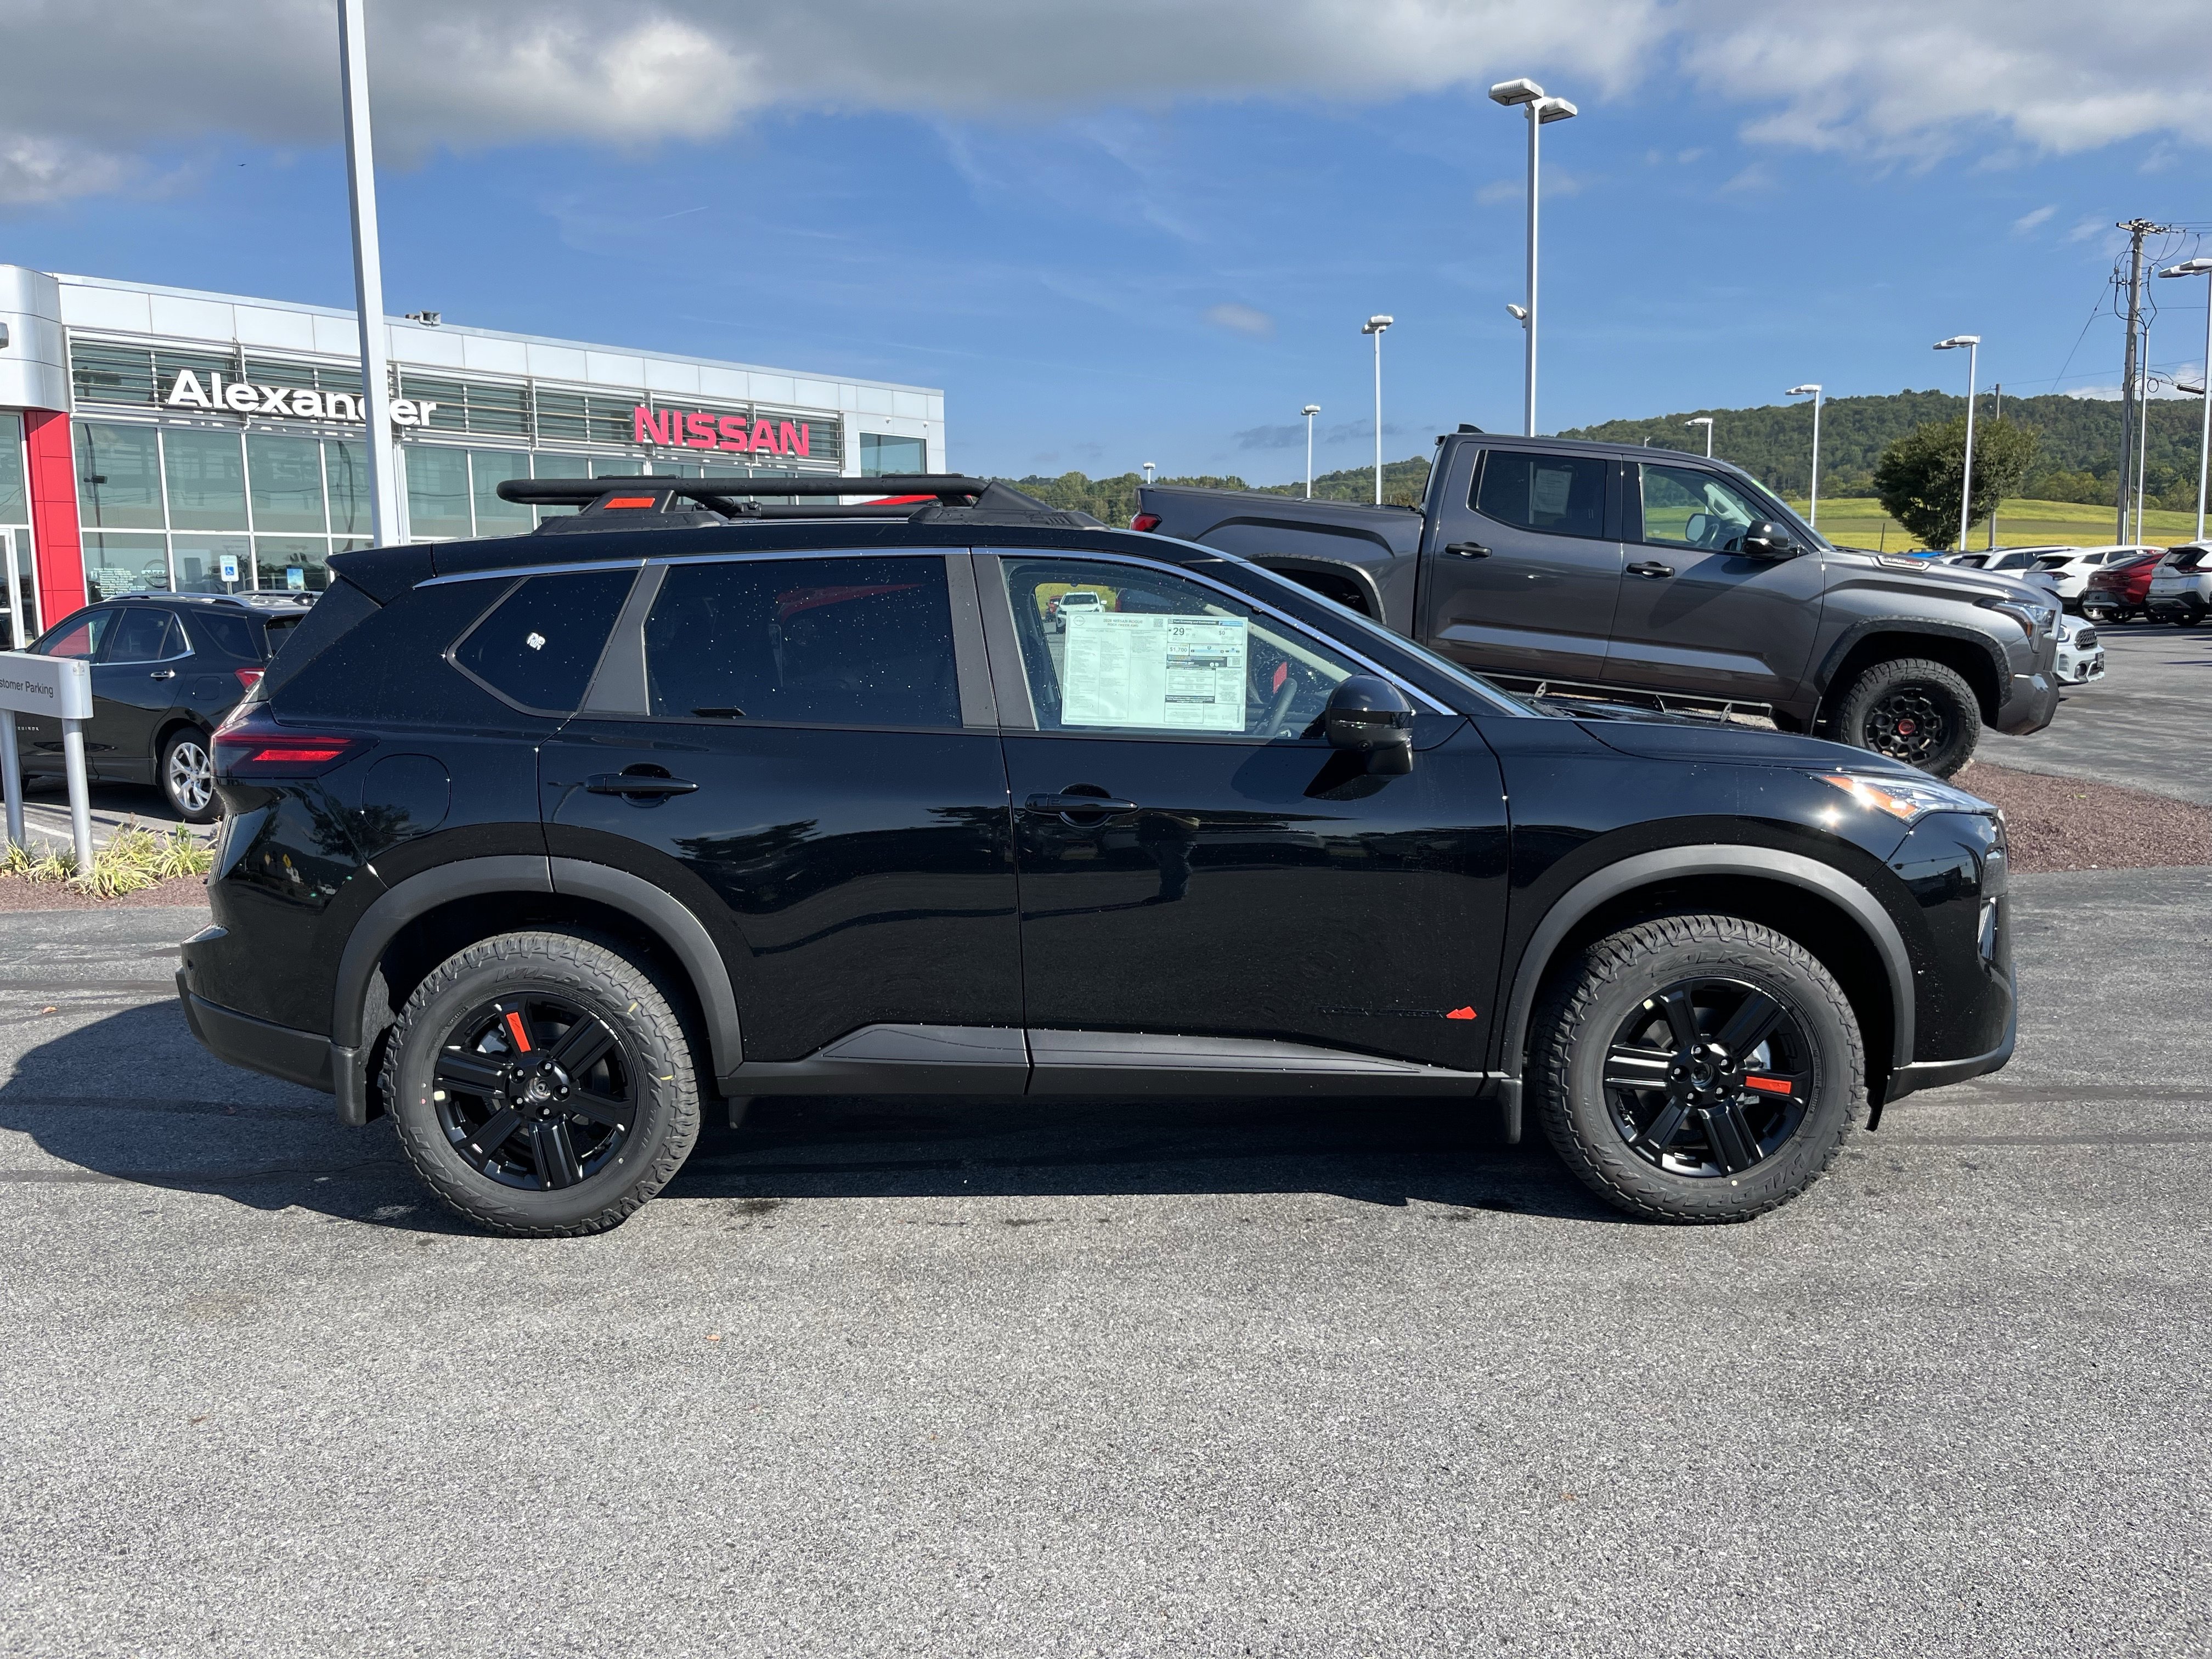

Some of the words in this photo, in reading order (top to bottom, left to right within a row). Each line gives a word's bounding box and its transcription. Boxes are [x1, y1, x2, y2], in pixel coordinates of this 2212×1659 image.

[168, 370, 437, 426] Alexaner
[634, 406, 809, 456] NISSAN
[1173, 627, 1185, 636] 29
[25, 681, 54, 698] Parking
